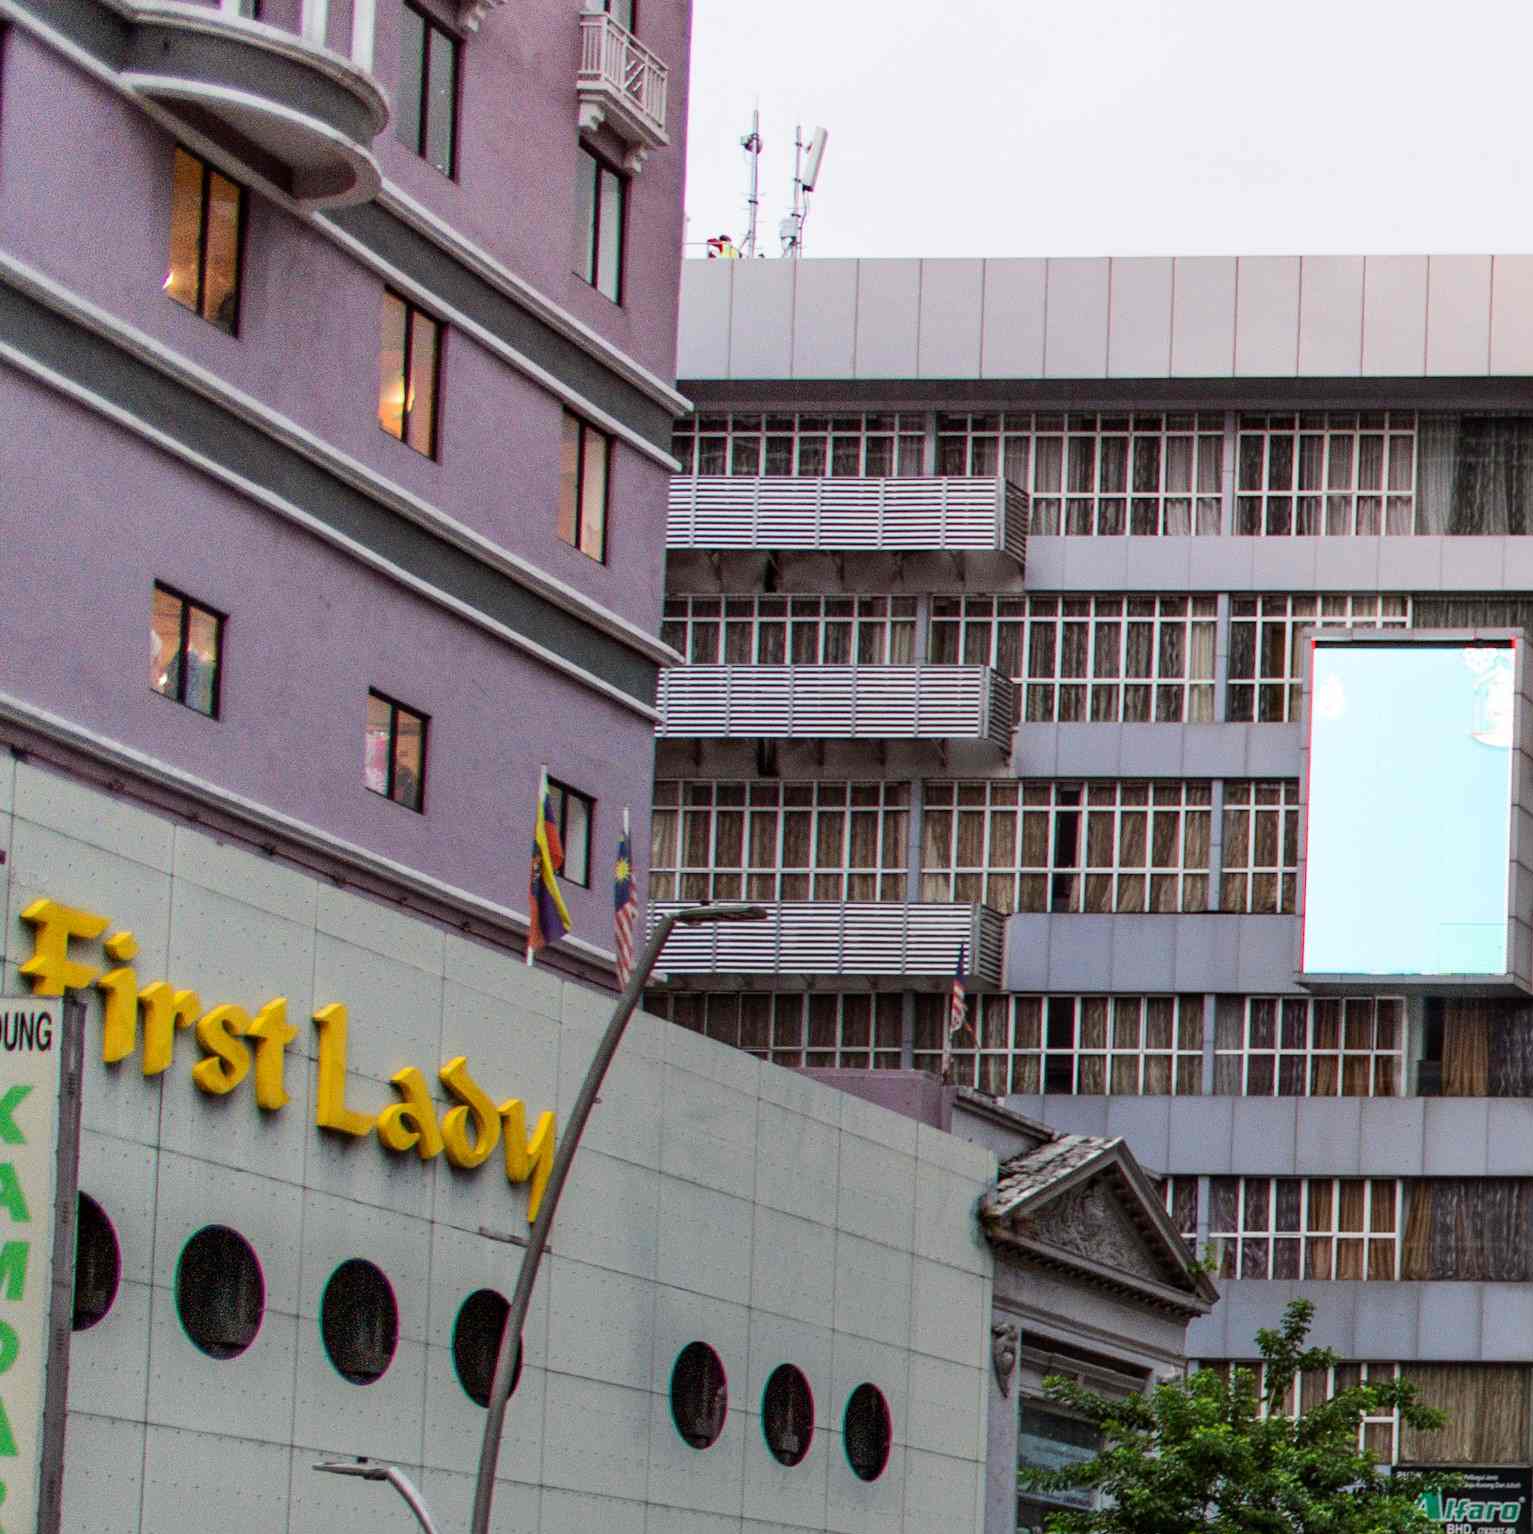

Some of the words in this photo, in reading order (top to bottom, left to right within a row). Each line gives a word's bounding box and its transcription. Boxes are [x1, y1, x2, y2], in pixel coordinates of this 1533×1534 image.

[19, 899, 297, 1111] First
[312, 1003, 557, 1223] Lady
[1415, 1486, 1521, 1523] Alfaro
